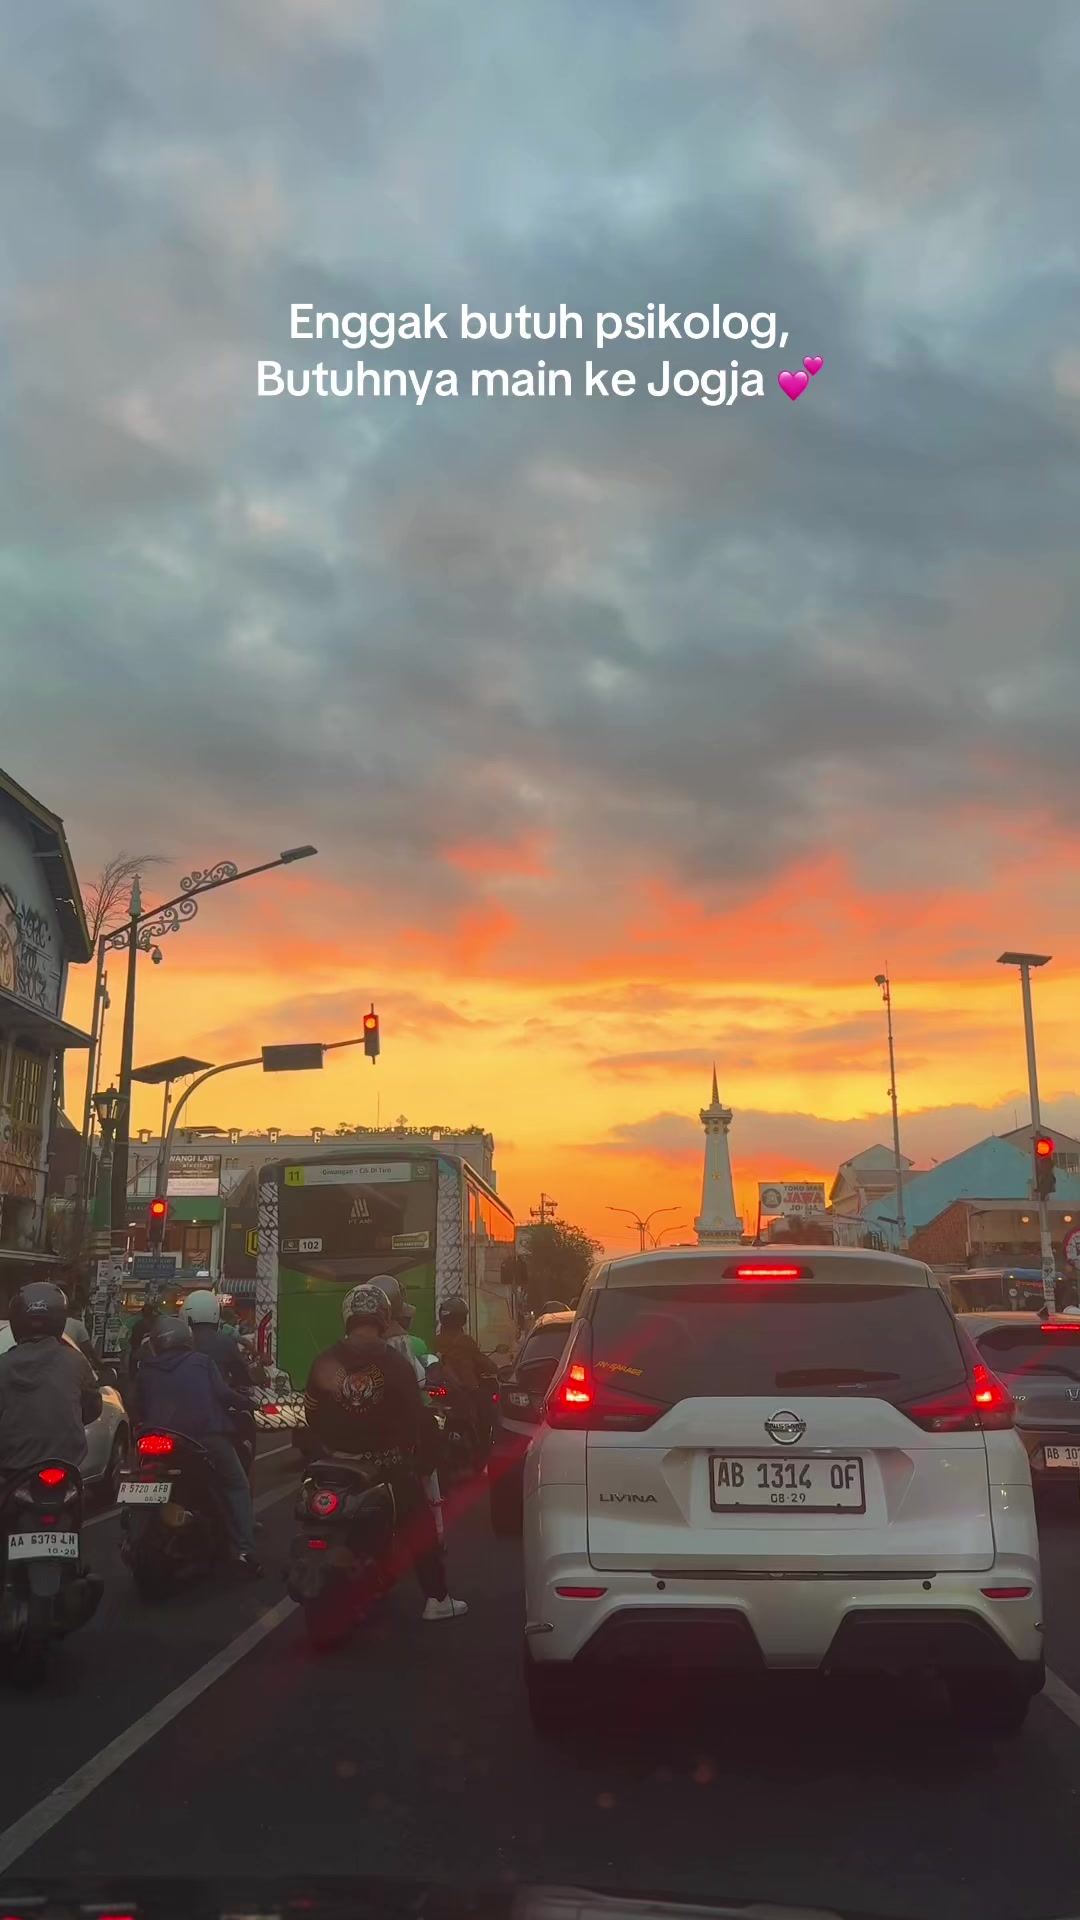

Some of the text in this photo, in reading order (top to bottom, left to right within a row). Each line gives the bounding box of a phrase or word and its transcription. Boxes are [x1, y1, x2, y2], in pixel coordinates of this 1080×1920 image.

[288, 1170, 300, 1182] 11
[783, 1191, 825, 1204] JAWA
[302, 1241, 319, 1250] 102
[1046, 1447, 1060, 1460] AB
[717, 1461, 857, 1490] AB 1314 OF
[120, 1484, 169, 1494] R 5720 AFB
[599, 1492, 659, 1504] LIVINA
[10, 1535, 24, 1547] AA
